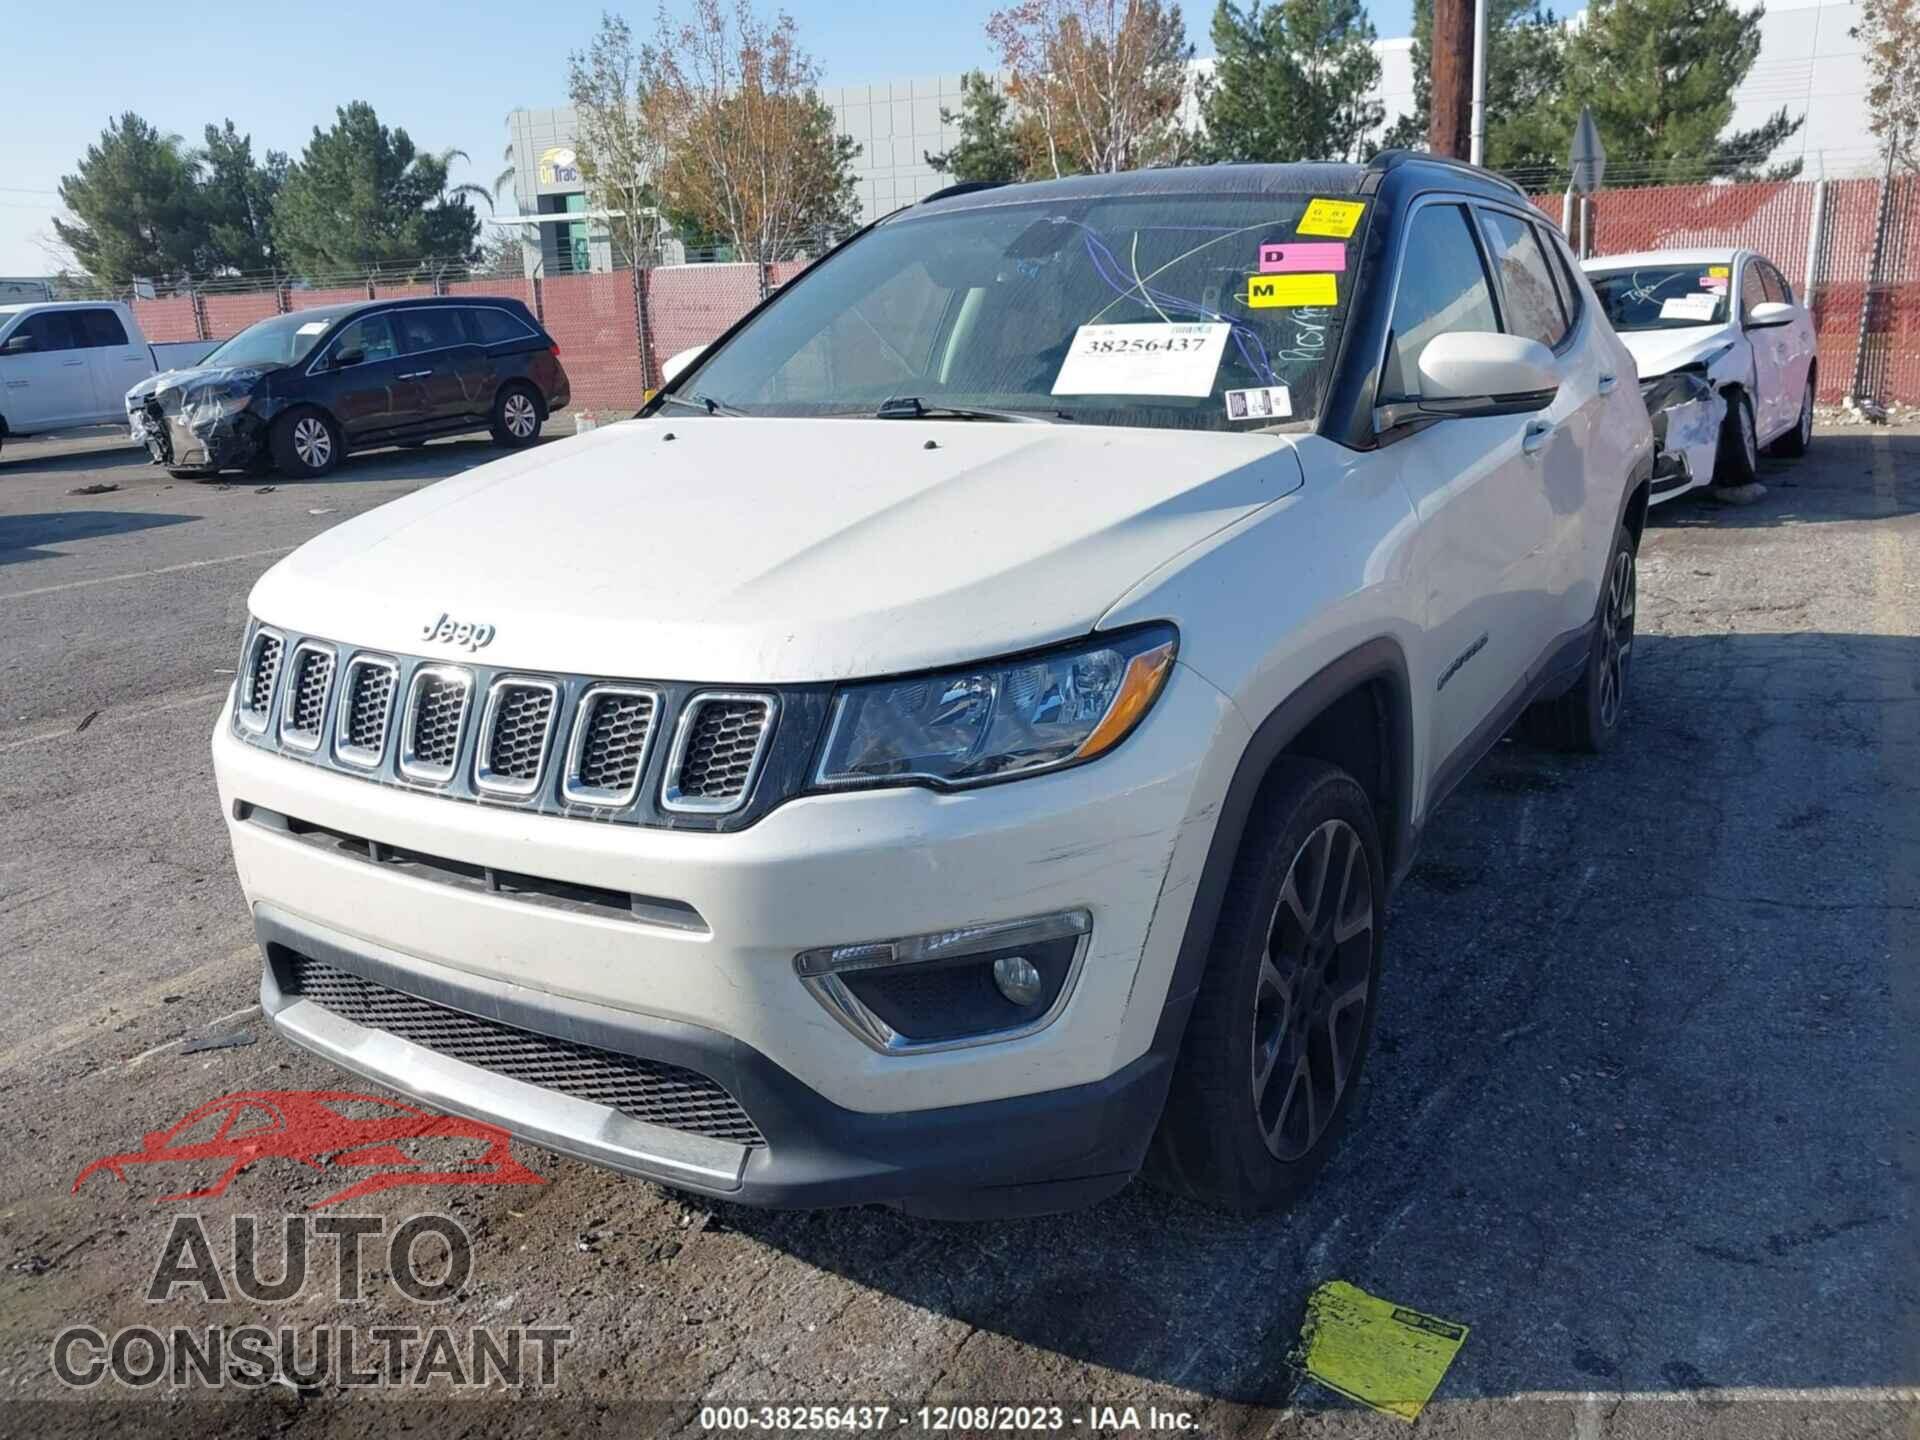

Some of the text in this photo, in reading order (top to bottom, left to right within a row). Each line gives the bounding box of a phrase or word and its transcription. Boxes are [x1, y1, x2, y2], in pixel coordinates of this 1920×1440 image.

[1264, 251, 1285, 263] D
[1252, 284, 1275, 297] M
[1085, 338, 1205, 354] 38256437
[422, 612, 496, 653] Jeep
